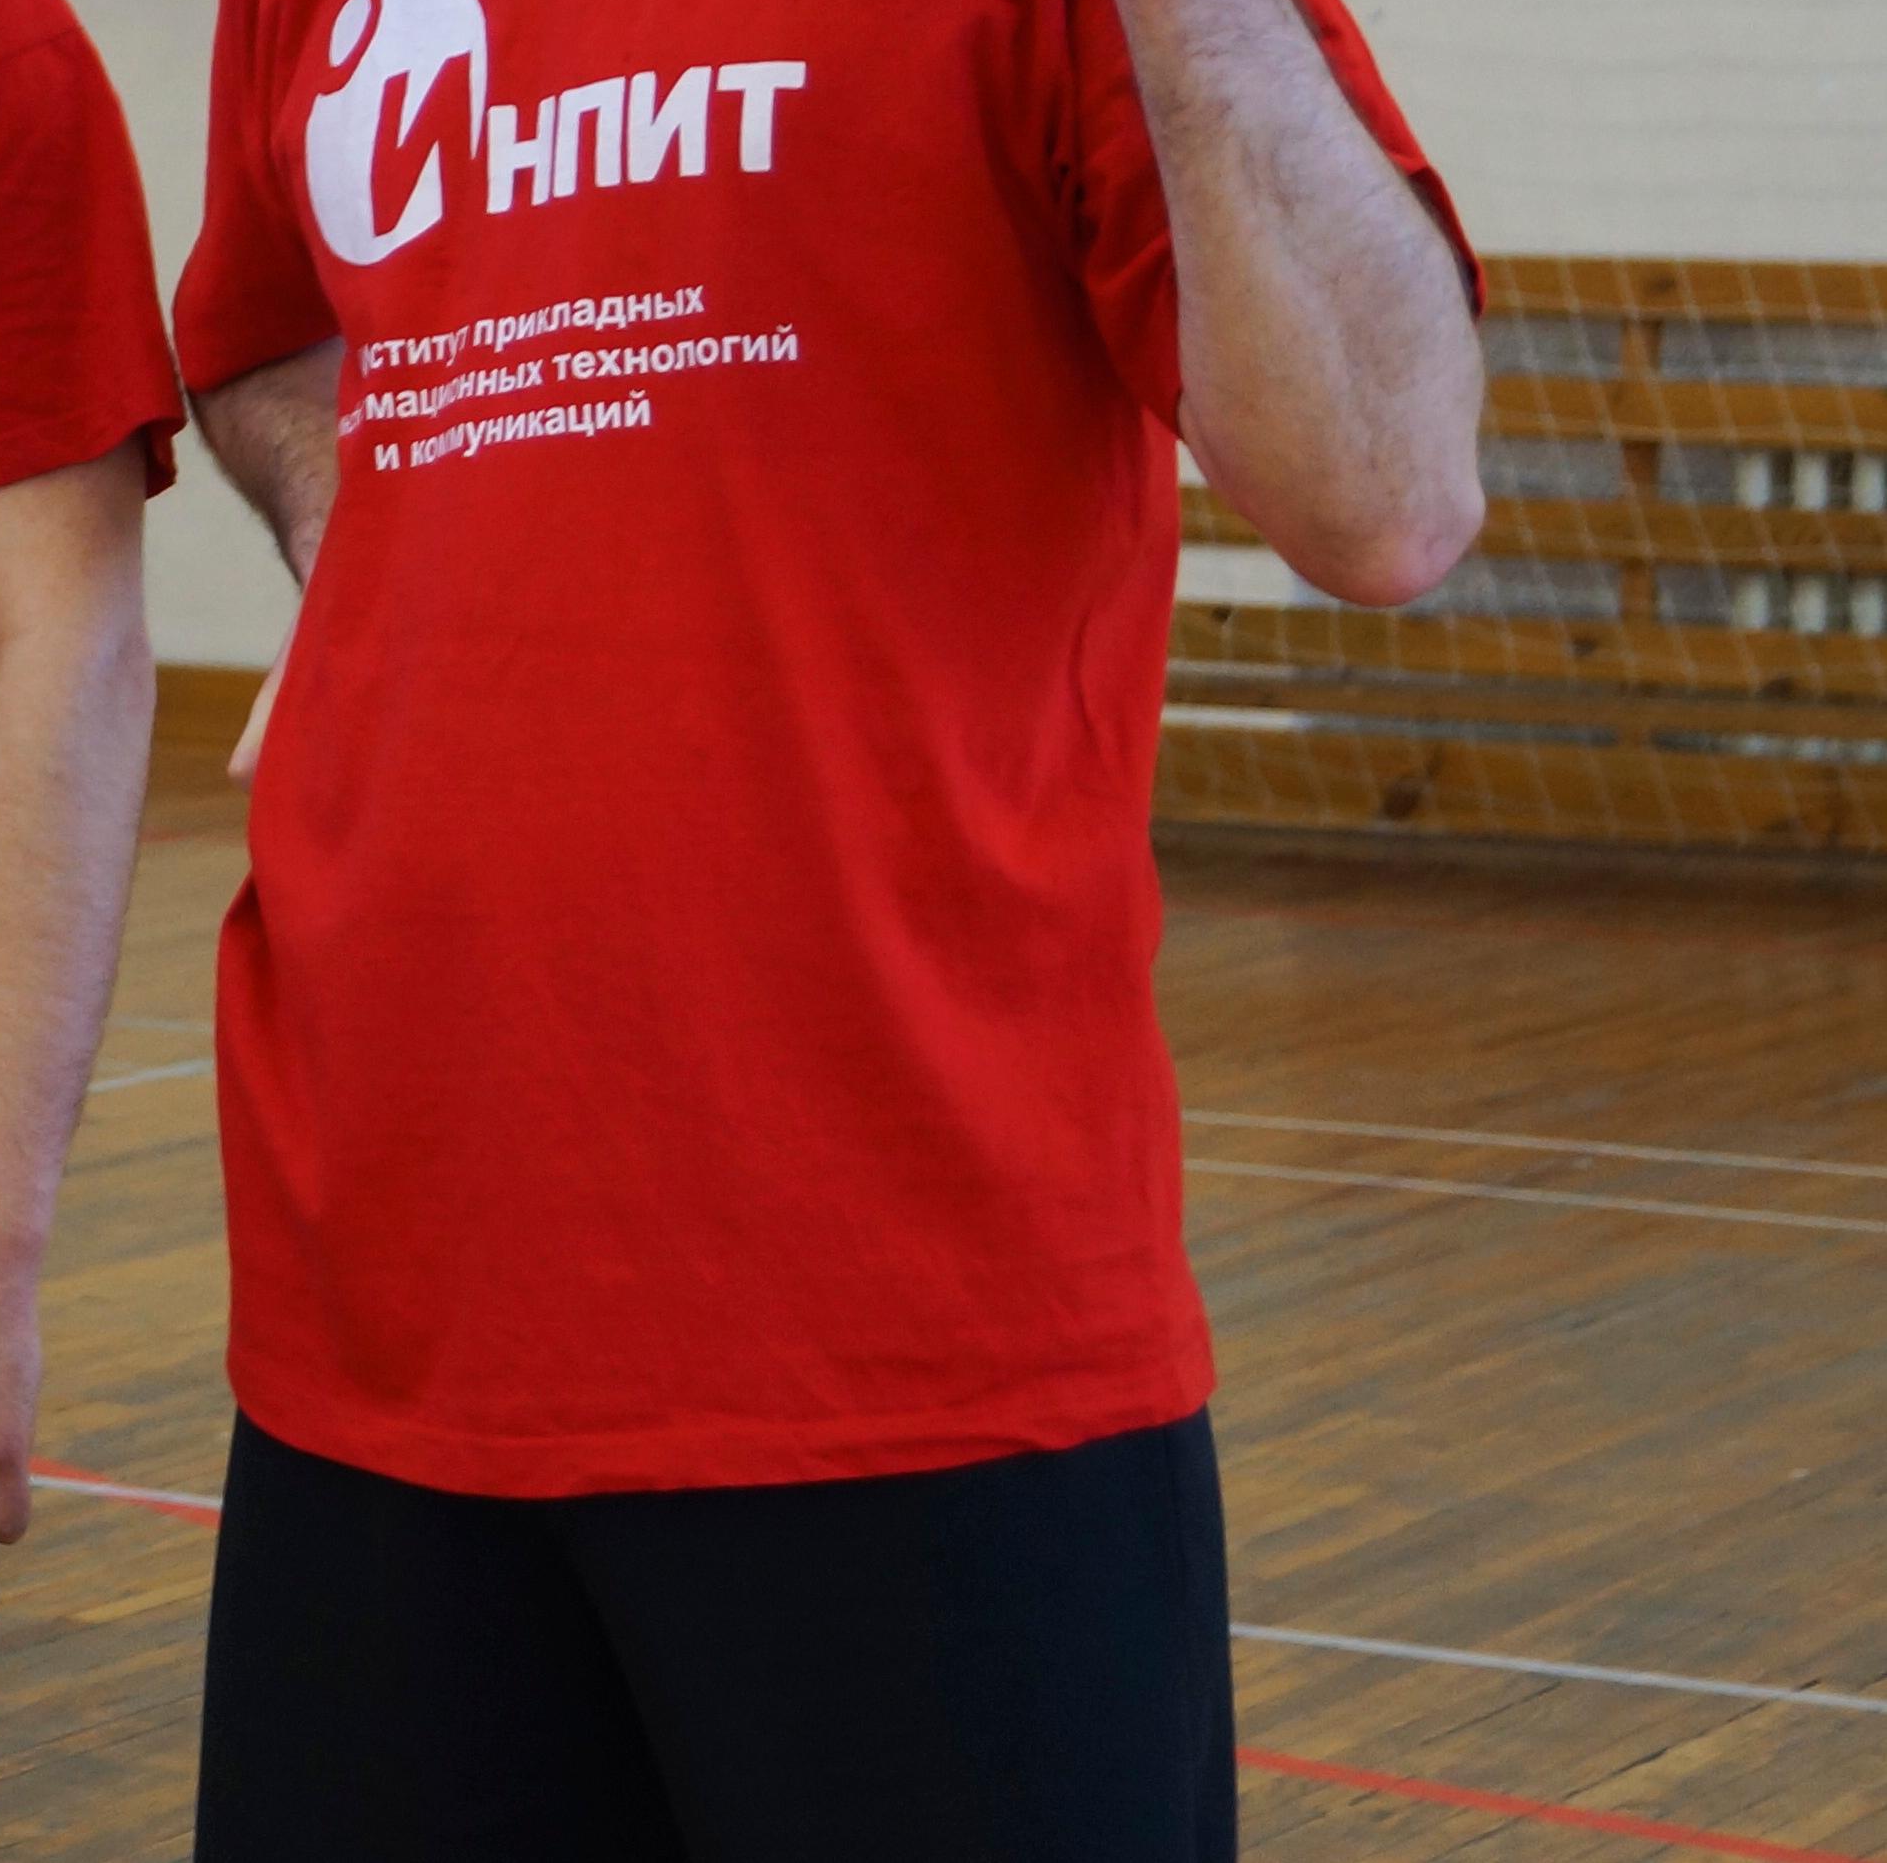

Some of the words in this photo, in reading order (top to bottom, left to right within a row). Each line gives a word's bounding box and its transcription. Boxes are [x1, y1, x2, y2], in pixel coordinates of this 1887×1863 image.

[472, 284, 706, 354] прикладных
[552, 322, 798, 382] технологий
[374, 442, 402, 472] и
